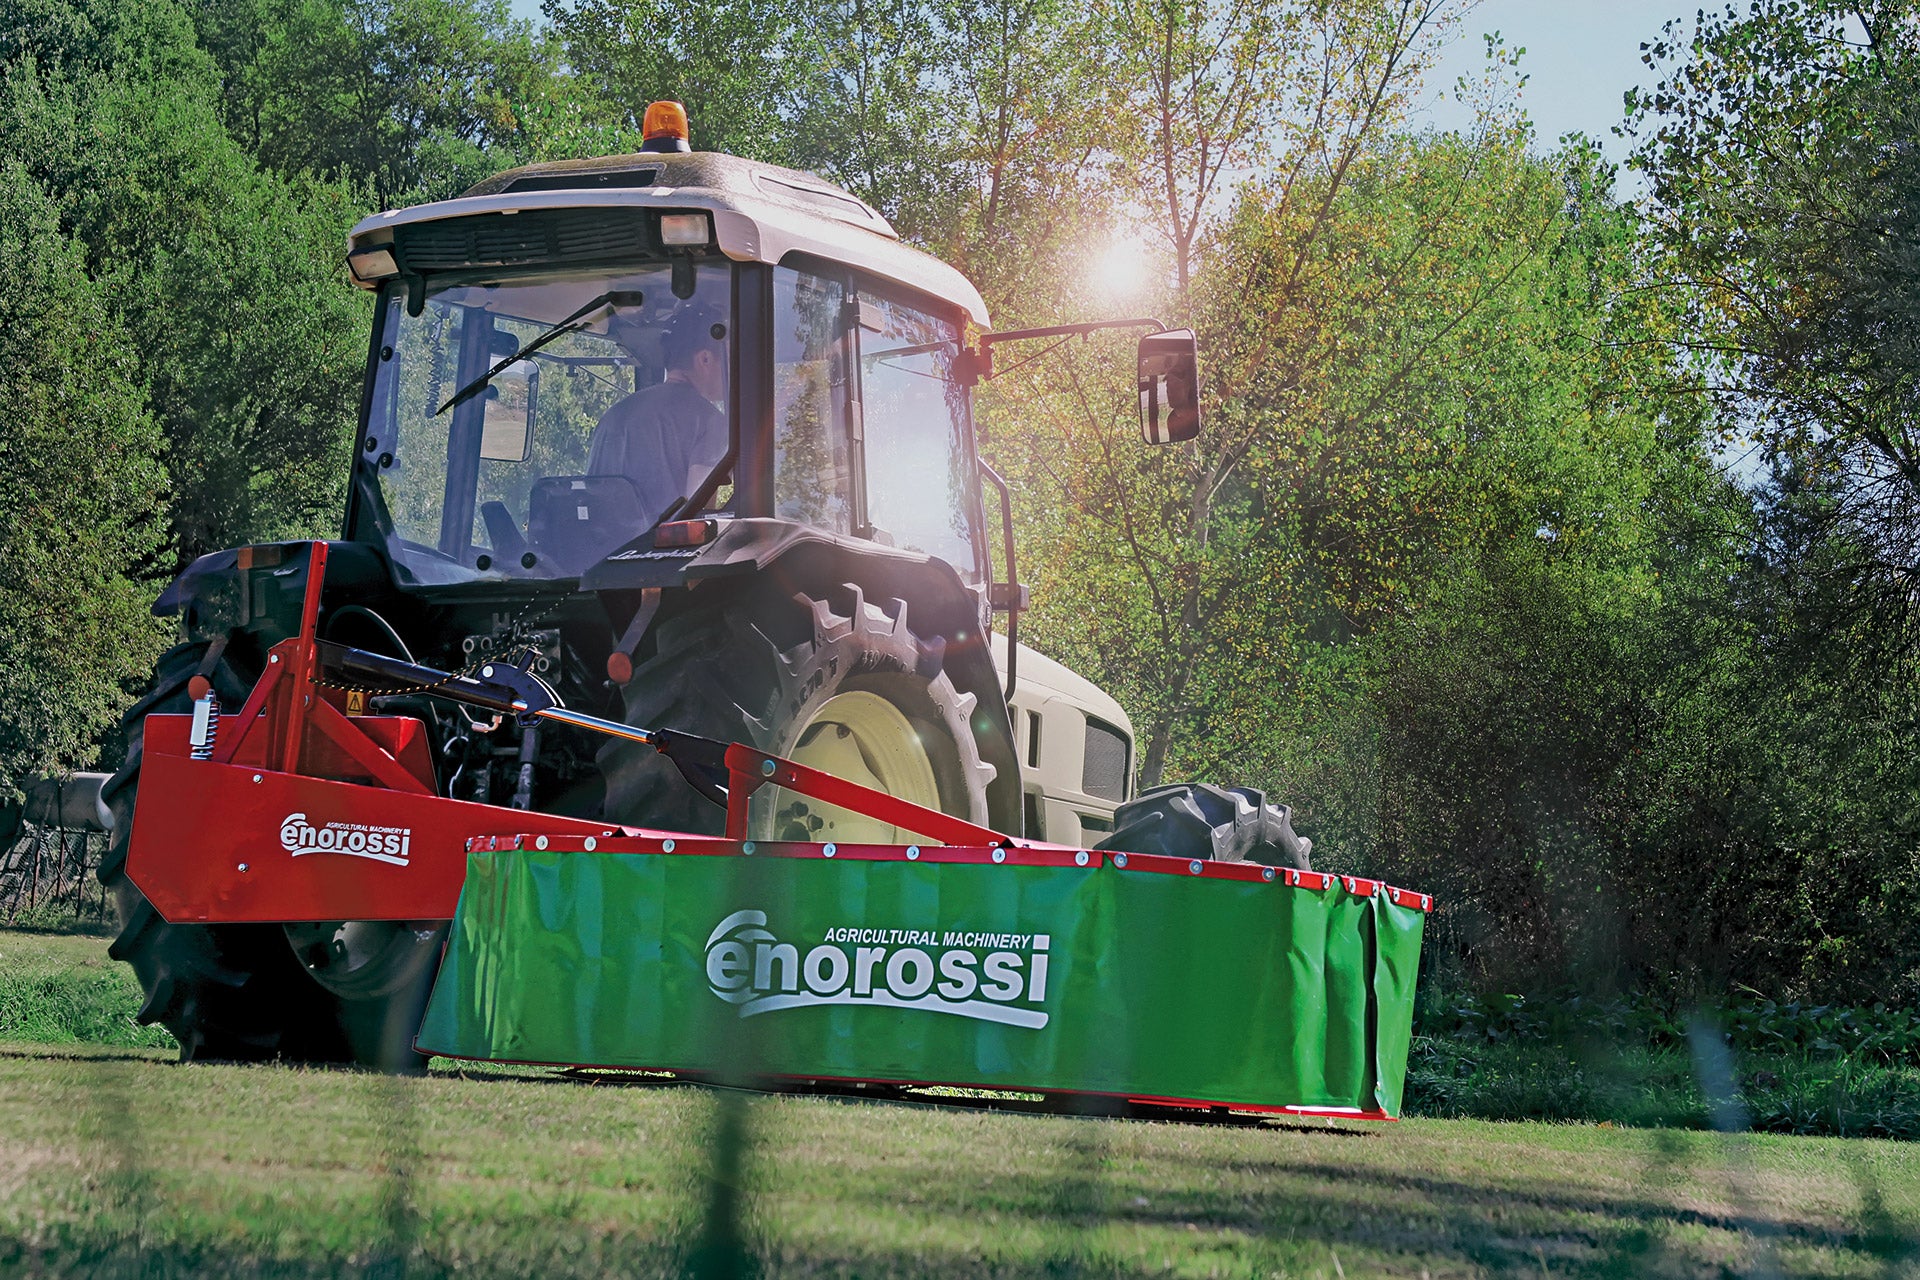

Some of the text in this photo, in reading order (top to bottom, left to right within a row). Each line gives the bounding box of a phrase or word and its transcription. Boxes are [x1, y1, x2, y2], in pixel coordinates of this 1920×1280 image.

[280, 824, 411, 856] enorossi
[326, 822, 403, 834] AGRICULTURAL MACHINERY
[824, 927, 1031, 949] AGRICULTURAL MACHINERY
[705, 934, 1050, 1001] enorossi
